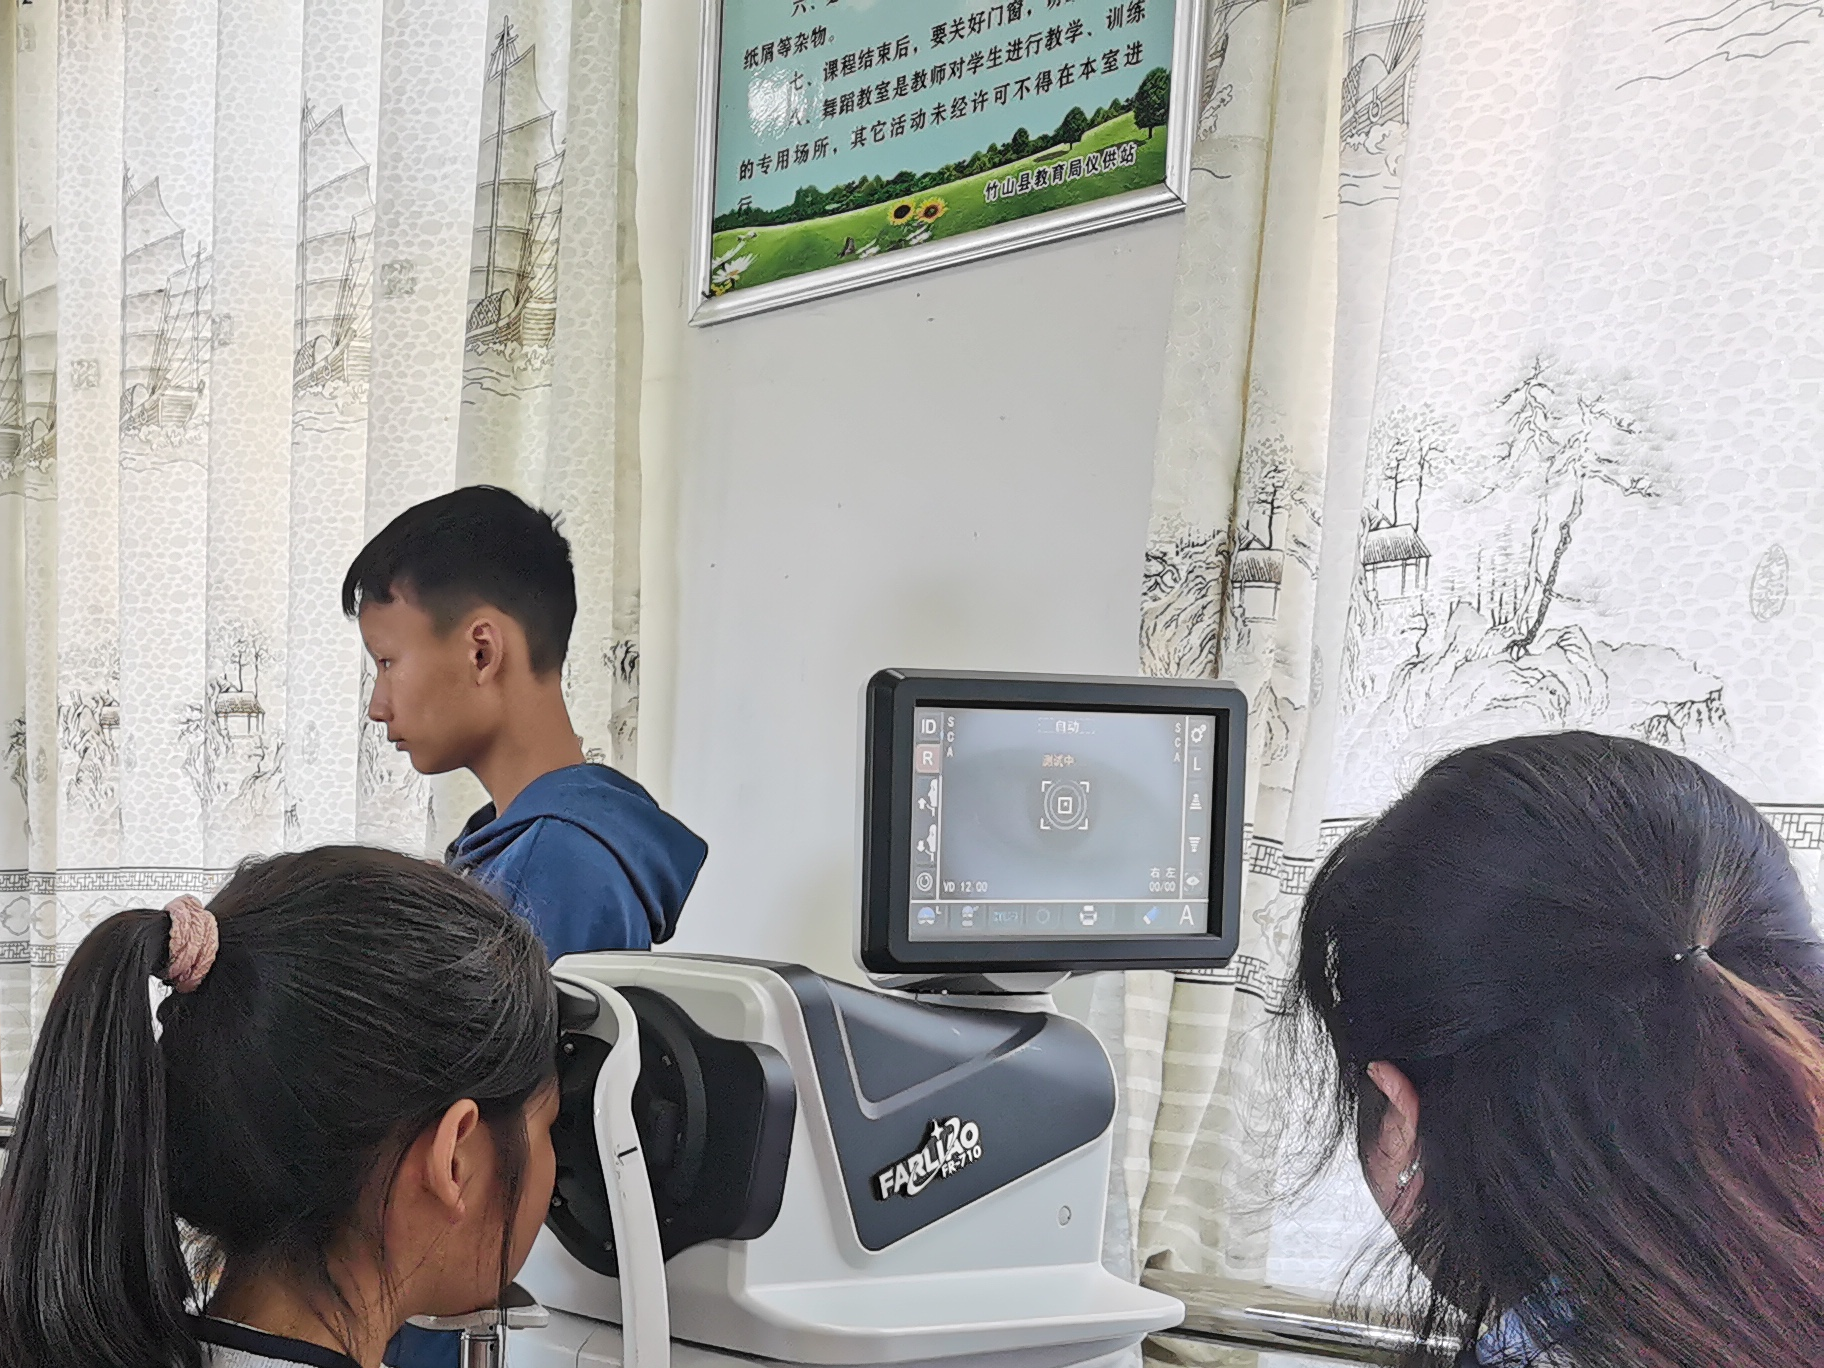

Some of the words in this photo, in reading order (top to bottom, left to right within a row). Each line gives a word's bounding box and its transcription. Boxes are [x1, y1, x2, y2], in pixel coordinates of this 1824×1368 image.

[984, 144, 1136, 200] 竹山县教育局仪供站
[921, 719, 937, 734] ID
[947, 717, 955, 728] S
[922, 752, 933, 766] R
[1193, 757, 1202, 771] L
[1179, 905, 1194, 926] A
[941, 1145, 982, 1178] FR-710
